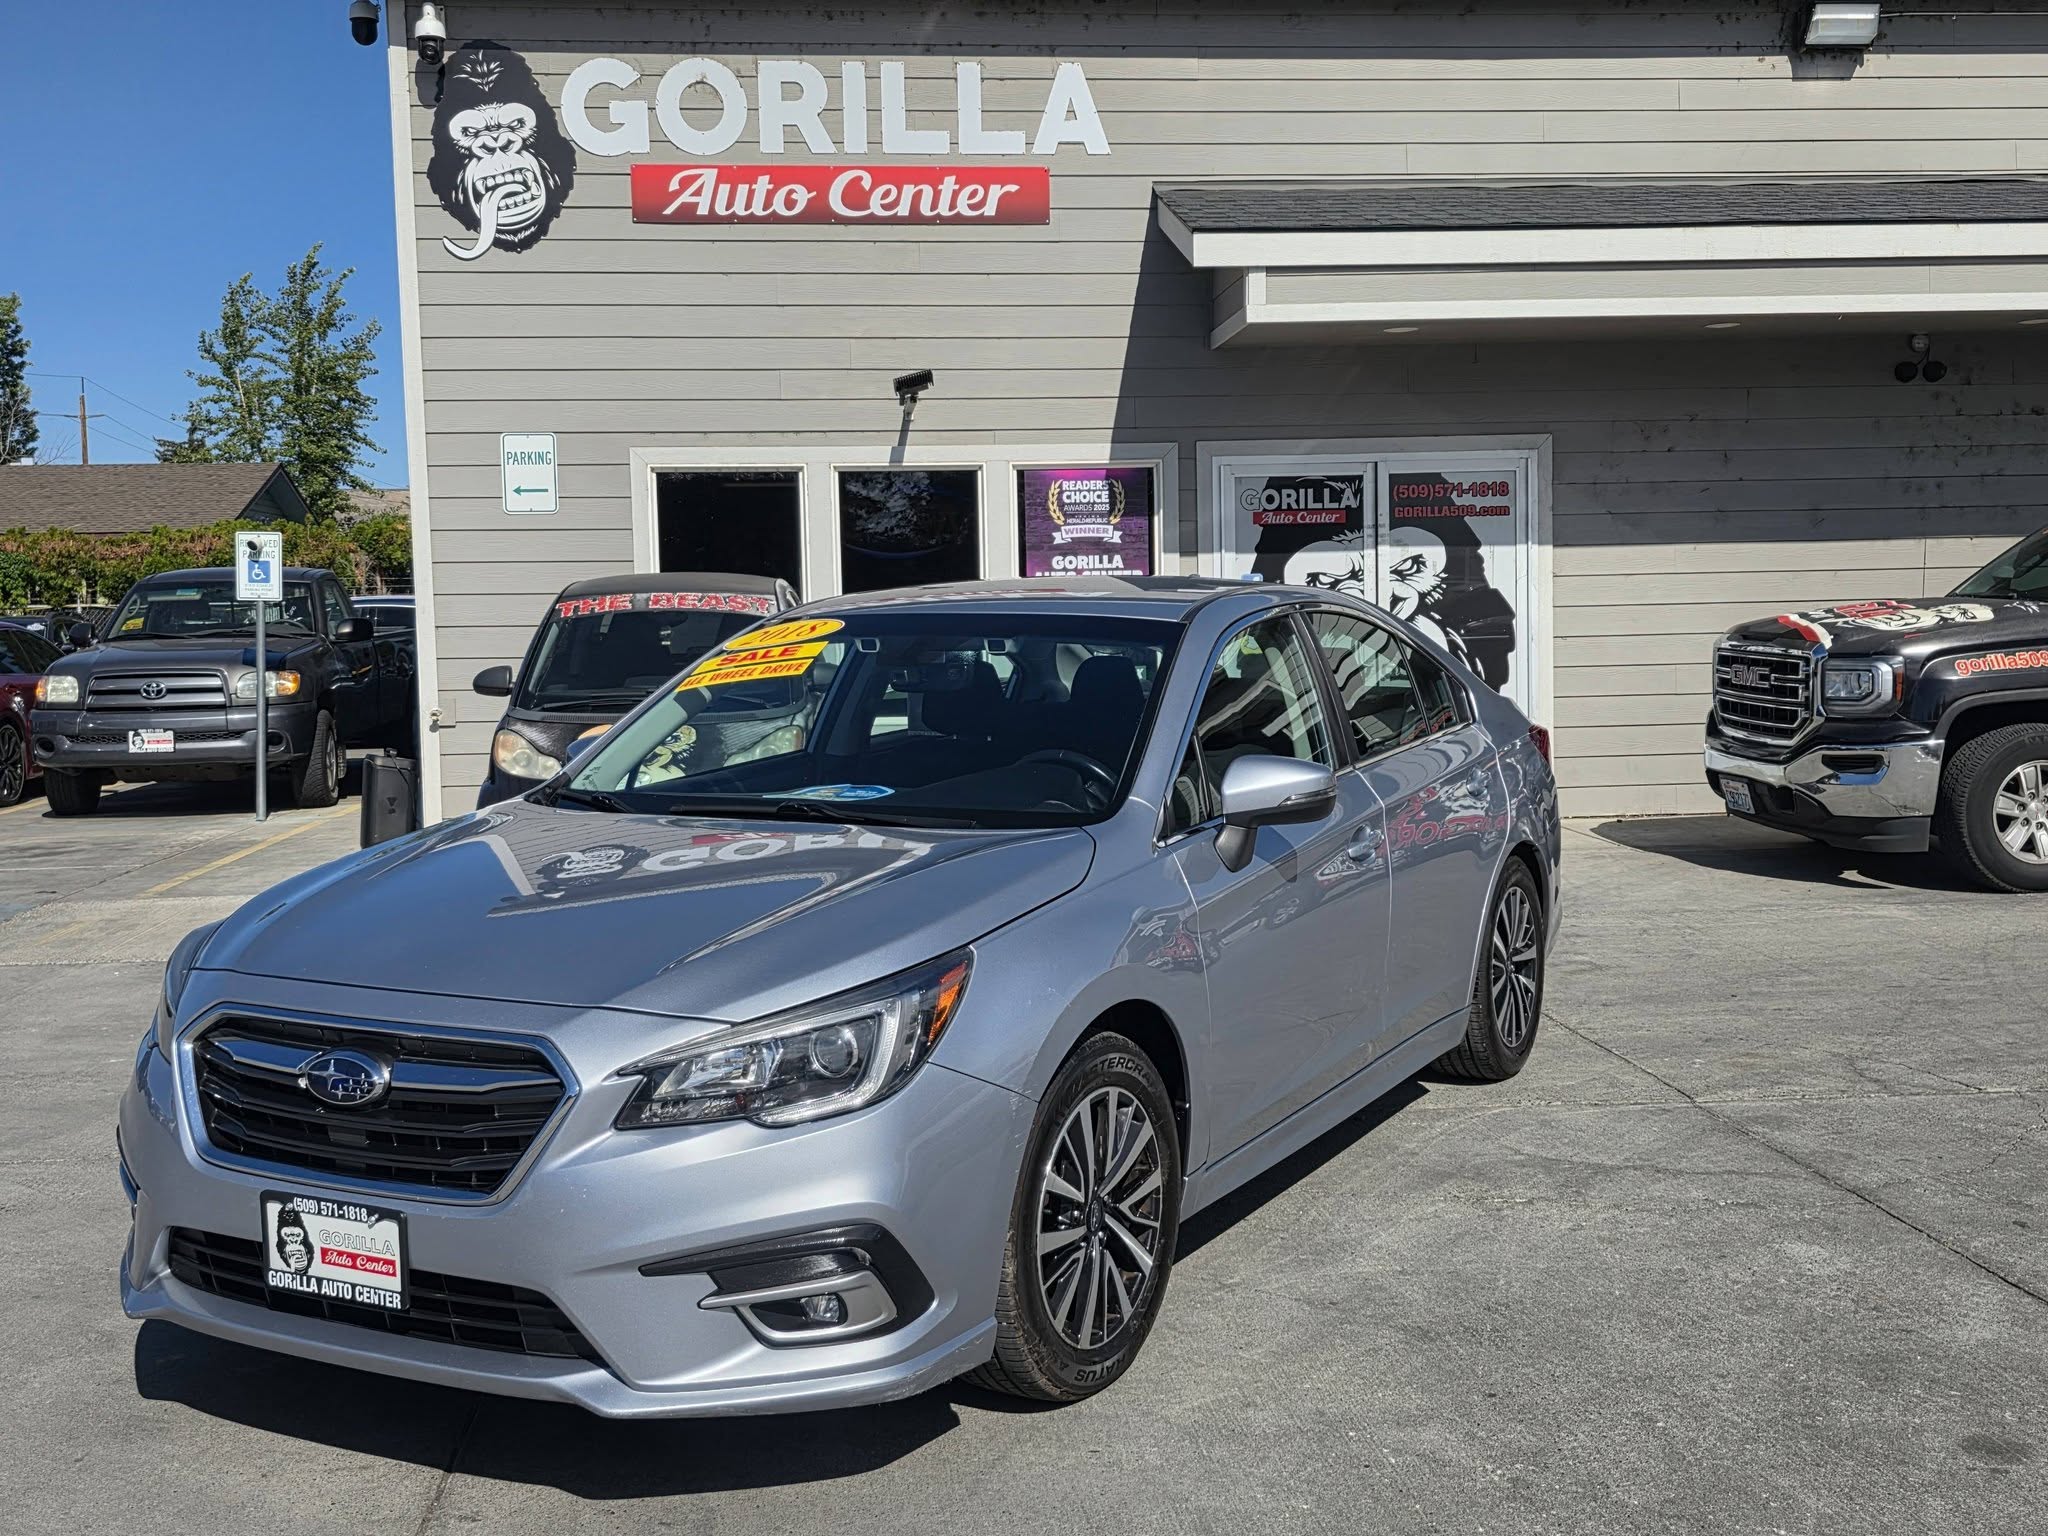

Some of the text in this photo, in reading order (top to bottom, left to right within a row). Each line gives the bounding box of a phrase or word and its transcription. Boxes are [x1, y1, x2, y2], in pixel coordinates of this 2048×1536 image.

[560, 57, 1112, 157] GORILLA
[662, 168, 1021, 217] Auto Center
[506, 451, 552, 466] PARKING
[1062, 491, 1110, 503] CHOICE
[1240, 487, 1359, 511] GORILLA
[1393, 481, 1510, 501] (509)571-1818
[1063, 504, 1093, 512] AWARDS
[1260, 512, 1340, 524] Auto Center
[1394, 503, 1511, 518] GORILLA509.com
[1063, 527, 1110, 535] WINNER
[1051, 554, 1125, 570] GORILLA
[556, 592, 774, 618] THE BEAST
[716, 645, 804, 667] SALE
[680, 661, 808, 689] ALL WHEEL DRIVE
[1731, 664, 1770, 689] GMC
[293, 1197, 368, 1222] (509) 571-1818
[319, 1229, 395, 1257] GORILLA
[325, 1250, 394, 1274] Auto Center
[268, 1270, 402, 1309] GORILLA AUTO CENTER
